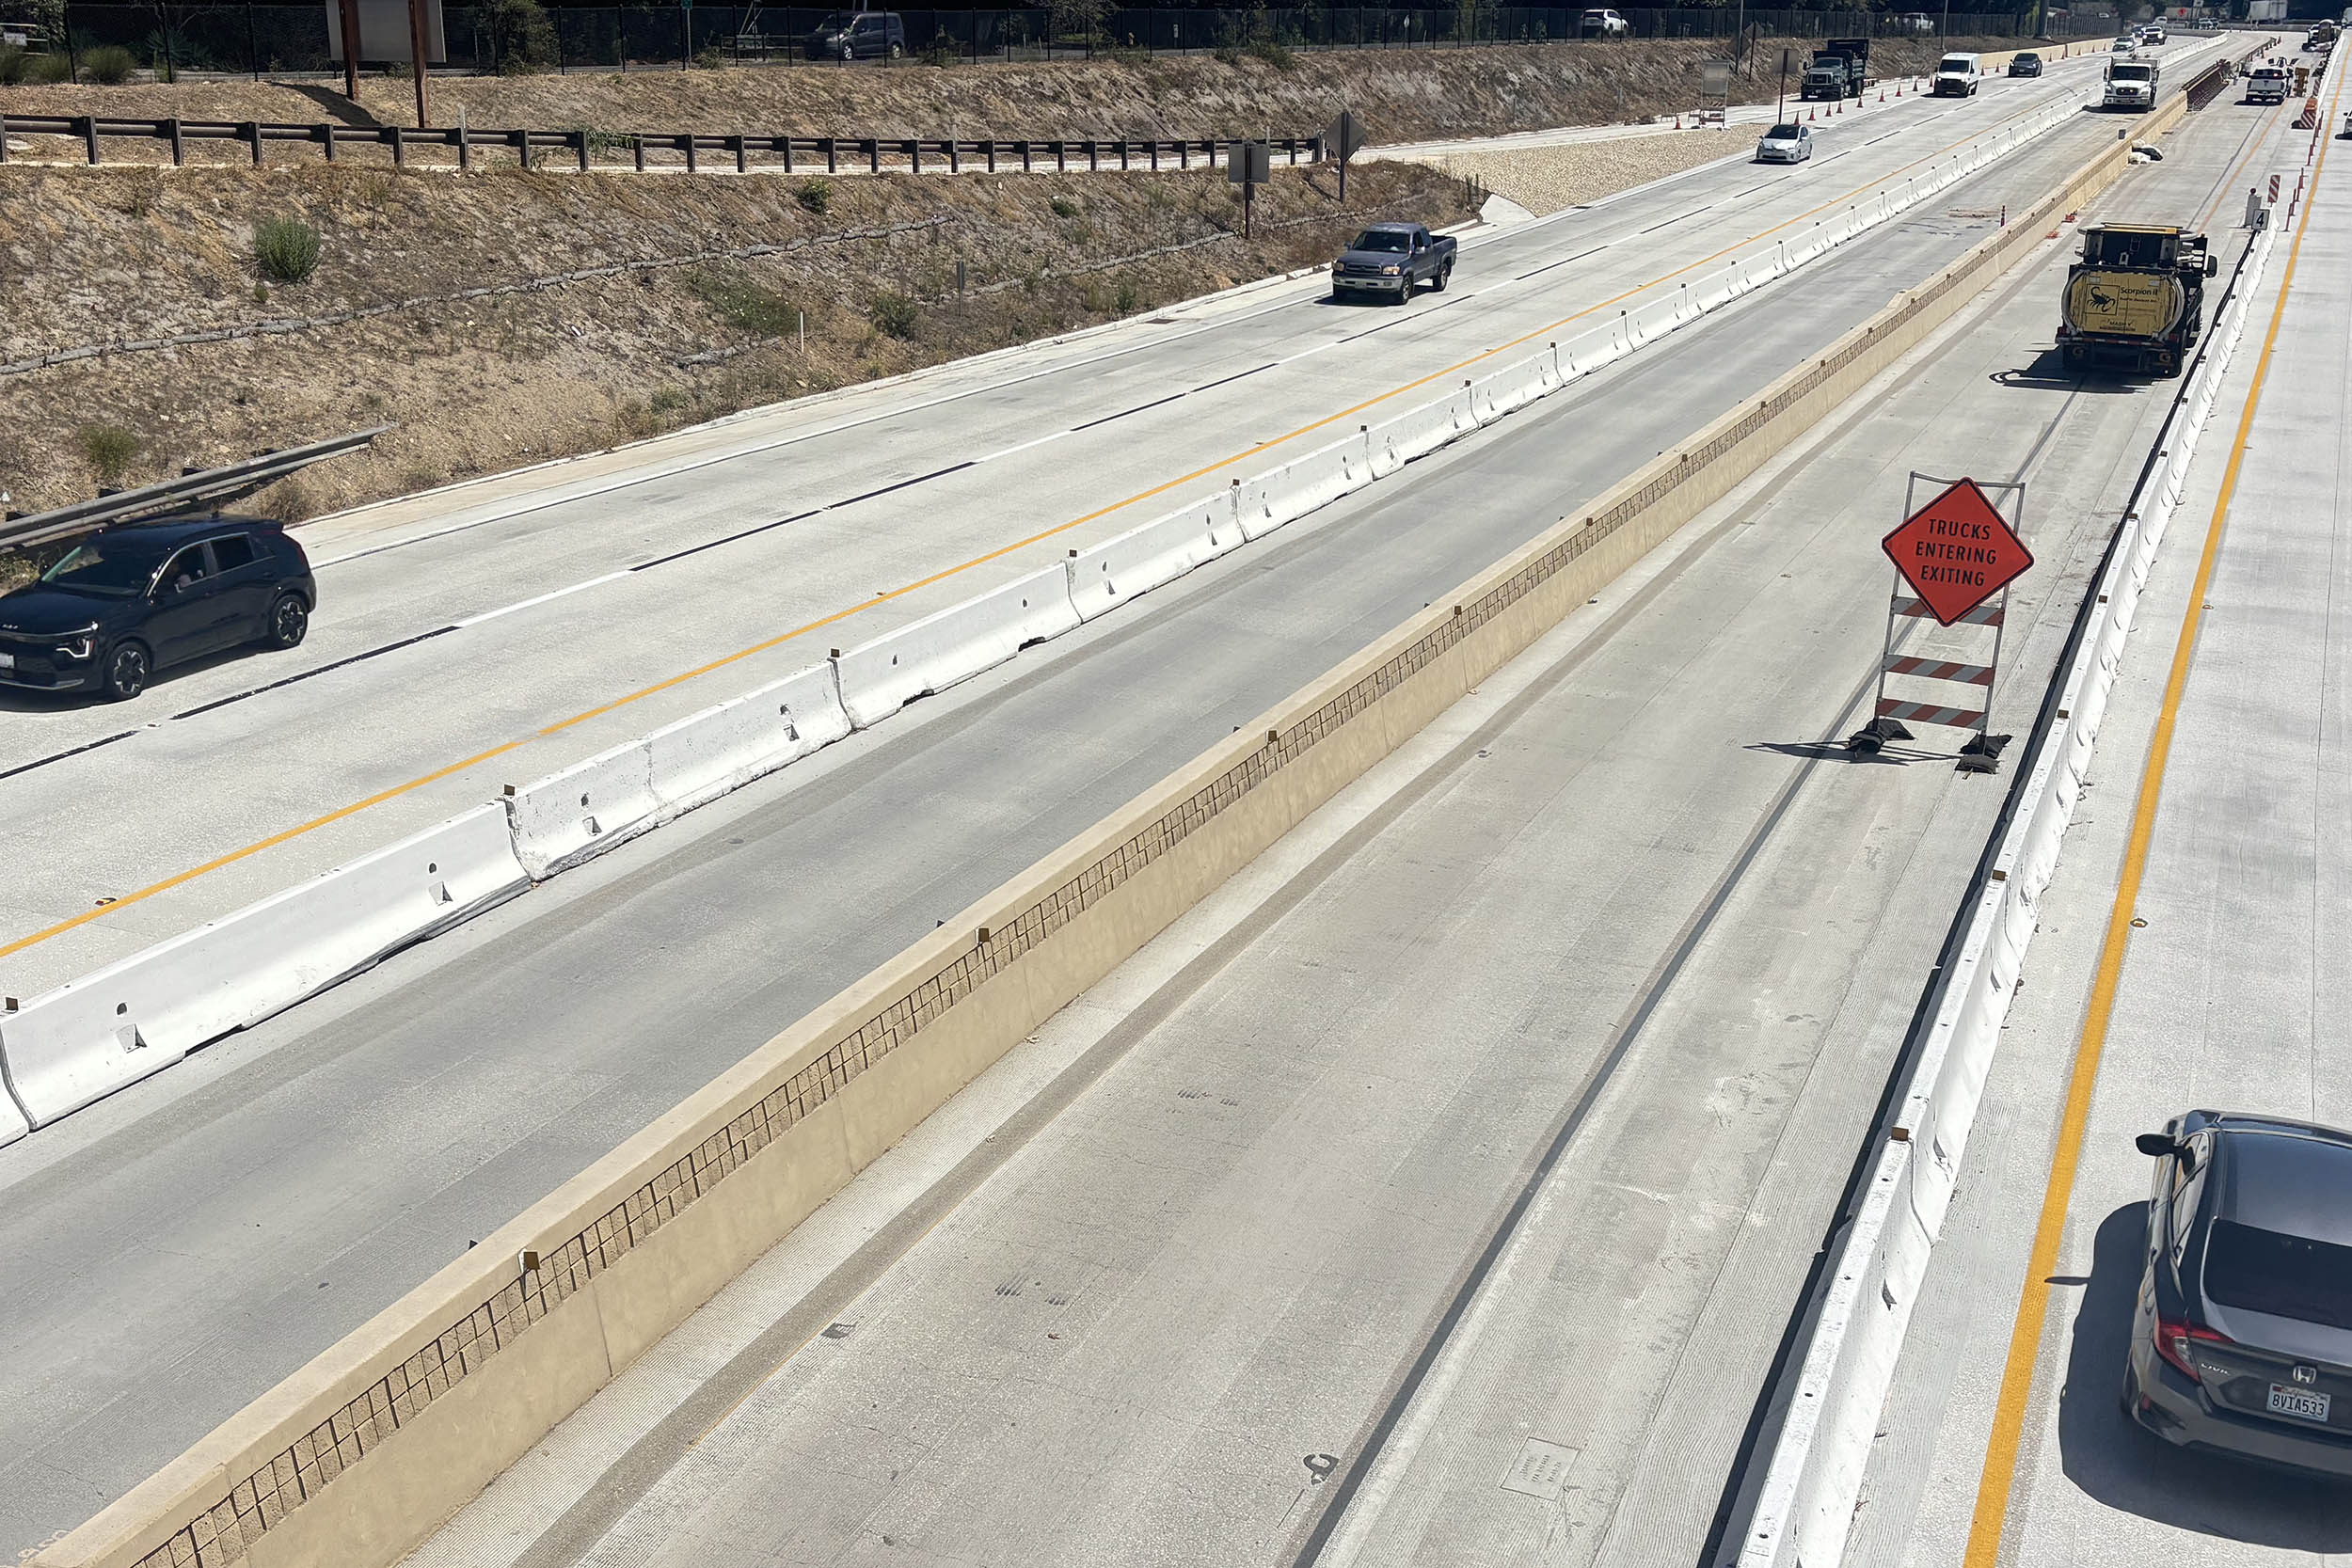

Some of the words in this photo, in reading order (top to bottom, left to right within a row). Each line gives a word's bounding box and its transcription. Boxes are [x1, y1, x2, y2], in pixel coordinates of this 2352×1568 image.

[2256, 212, 2265, 227] 4
[2120, 287, 2152, 297] Scorpion
[1929, 518, 1991, 541] TRUCKS
[1915, 541, 1997, 565] ENTERING
[1920, 564, 1985, 587] EXITING
[2272, 1393, 2325, 1417] 8VIA533
